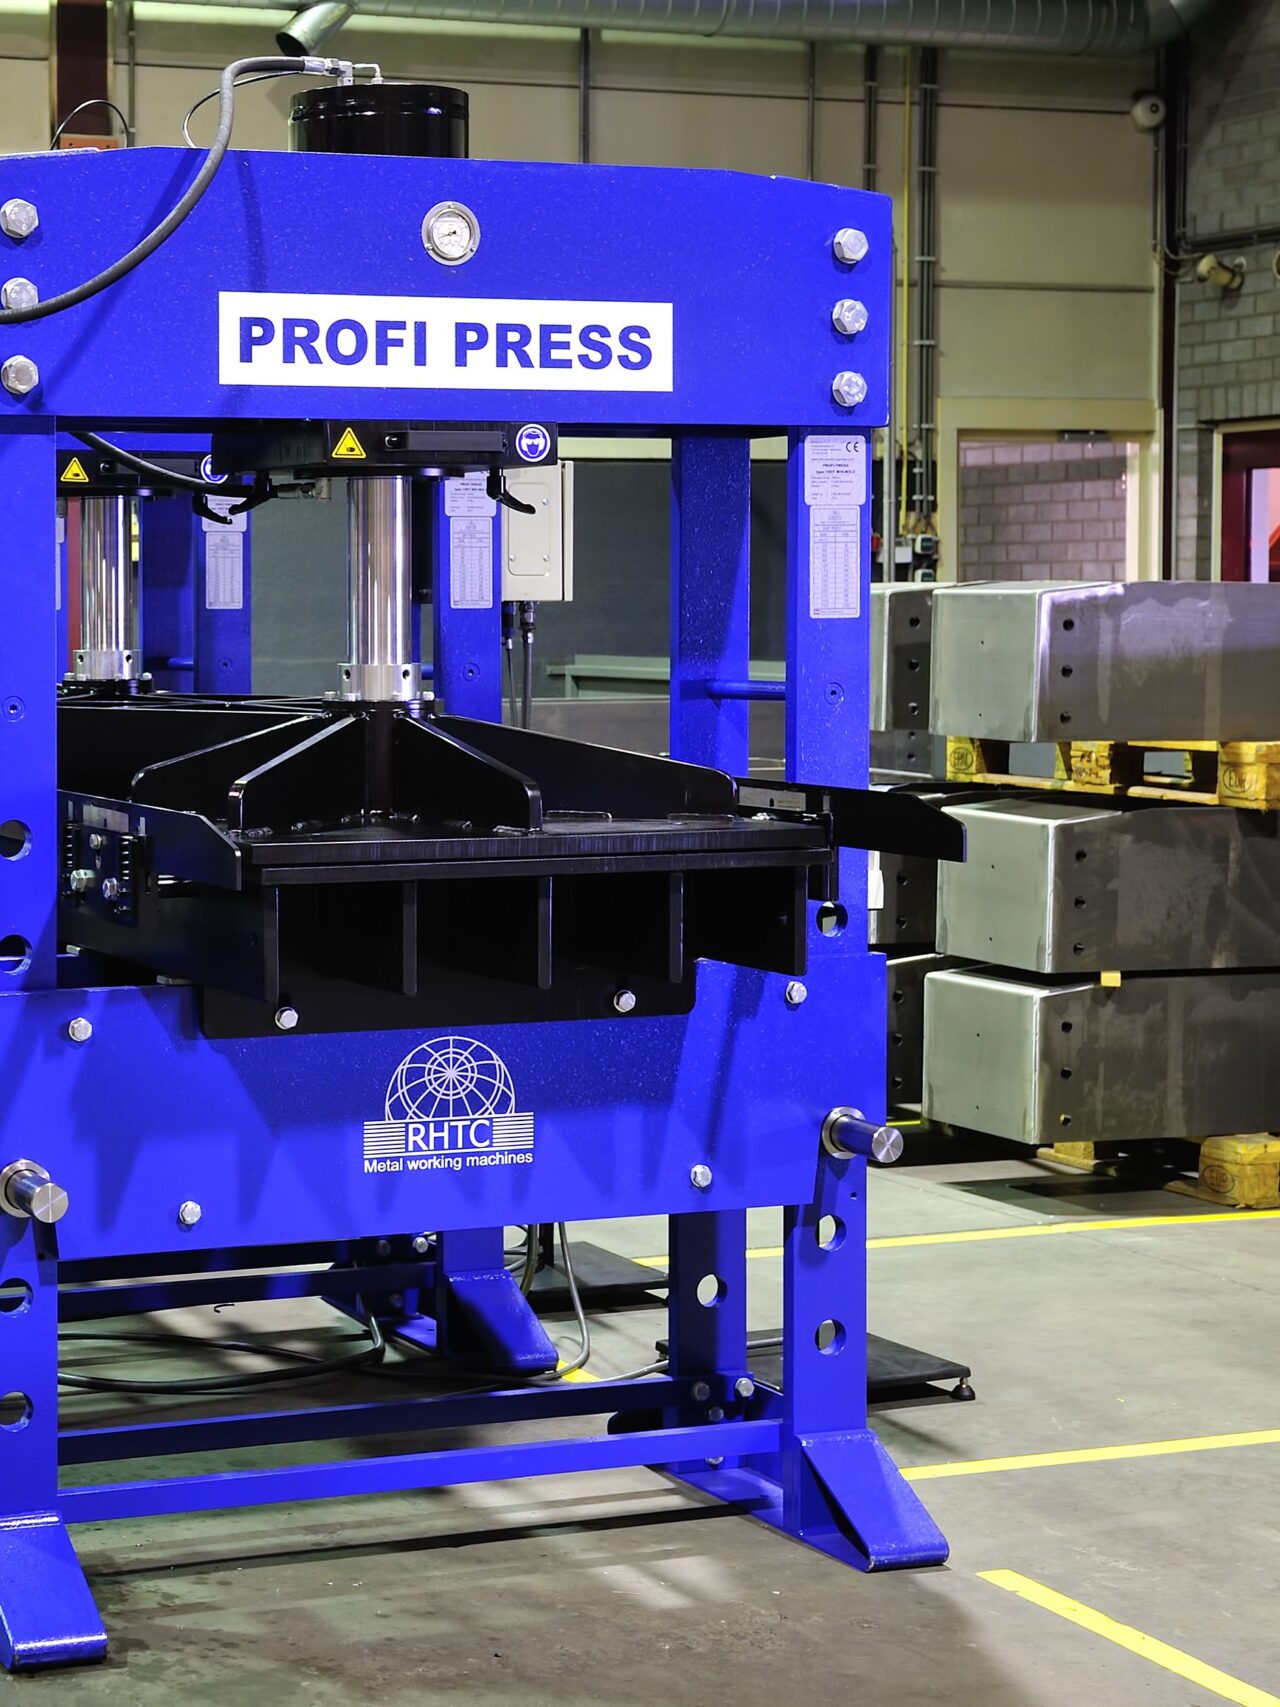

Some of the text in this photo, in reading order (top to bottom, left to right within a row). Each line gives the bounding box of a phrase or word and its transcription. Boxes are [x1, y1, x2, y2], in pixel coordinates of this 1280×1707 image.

[239, 316, 653, 371] PROFI PRESS
[407, 1119, 490, 1152] RHTC
[363, 1151, 534, 1174] Metal working machines
